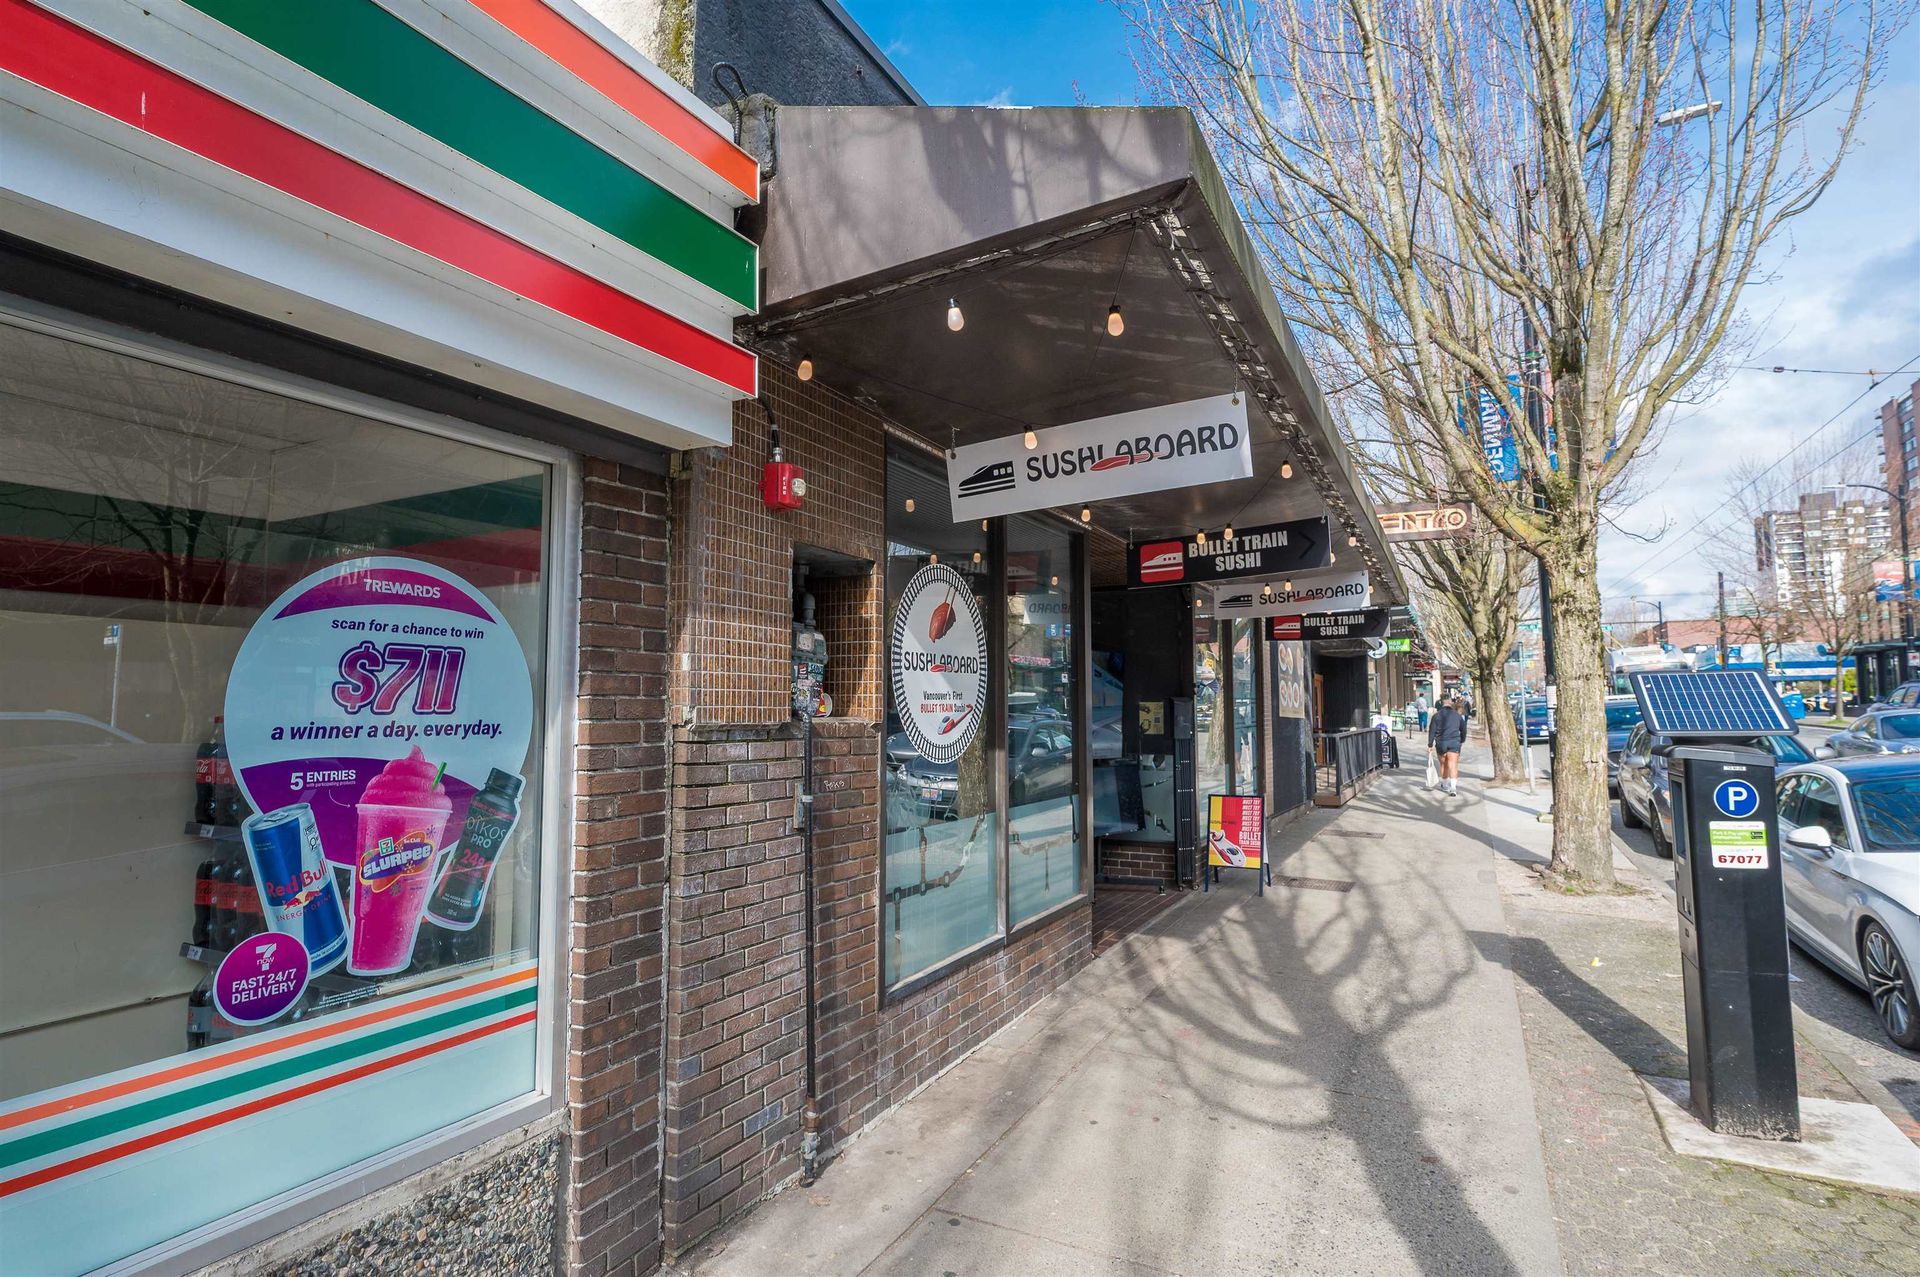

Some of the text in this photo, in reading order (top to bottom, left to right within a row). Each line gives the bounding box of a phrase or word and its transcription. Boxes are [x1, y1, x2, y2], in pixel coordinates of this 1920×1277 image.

[1026, 422, 1239, 482] SUSHI ABOARD
[1188, 530, 1288, 558] BULLET TRAIN
[1215, 551, 1261, 572] SUSHI
[364, 579, 441, 599] 7REWARDS
[1259, 583, 1364, 605] SUSHI ABOARD
[331, 619, 484, 640] scan for a chance to win
[1303, 614, 1365, 627] BULLET TRAIN
[1320, 626, 1348, 636] SUSHI
[904, 651, 979, 674] SUSHI ABOARD
[332, 640, 466, 715] $711
[923, 690, 963, 700] Vancouver's First
[920, 703, 938, 713] BULLET
[939, 703, 953, 713] TRAIN
[271, 720, 503, 741] a winner a day. everyday.
[290, 769, 356, 790] 5 ENTRIES
[1728, 786, 1748, 811] P
[471, 833, 492, 848] PRO
[1718, 855, 1762, 864] 67077
[266, 858, 327, 898] Red Bull
[232, 968, 297, 992] FAST 24/7
[231, 980, 297, 1005] DELIVERY
